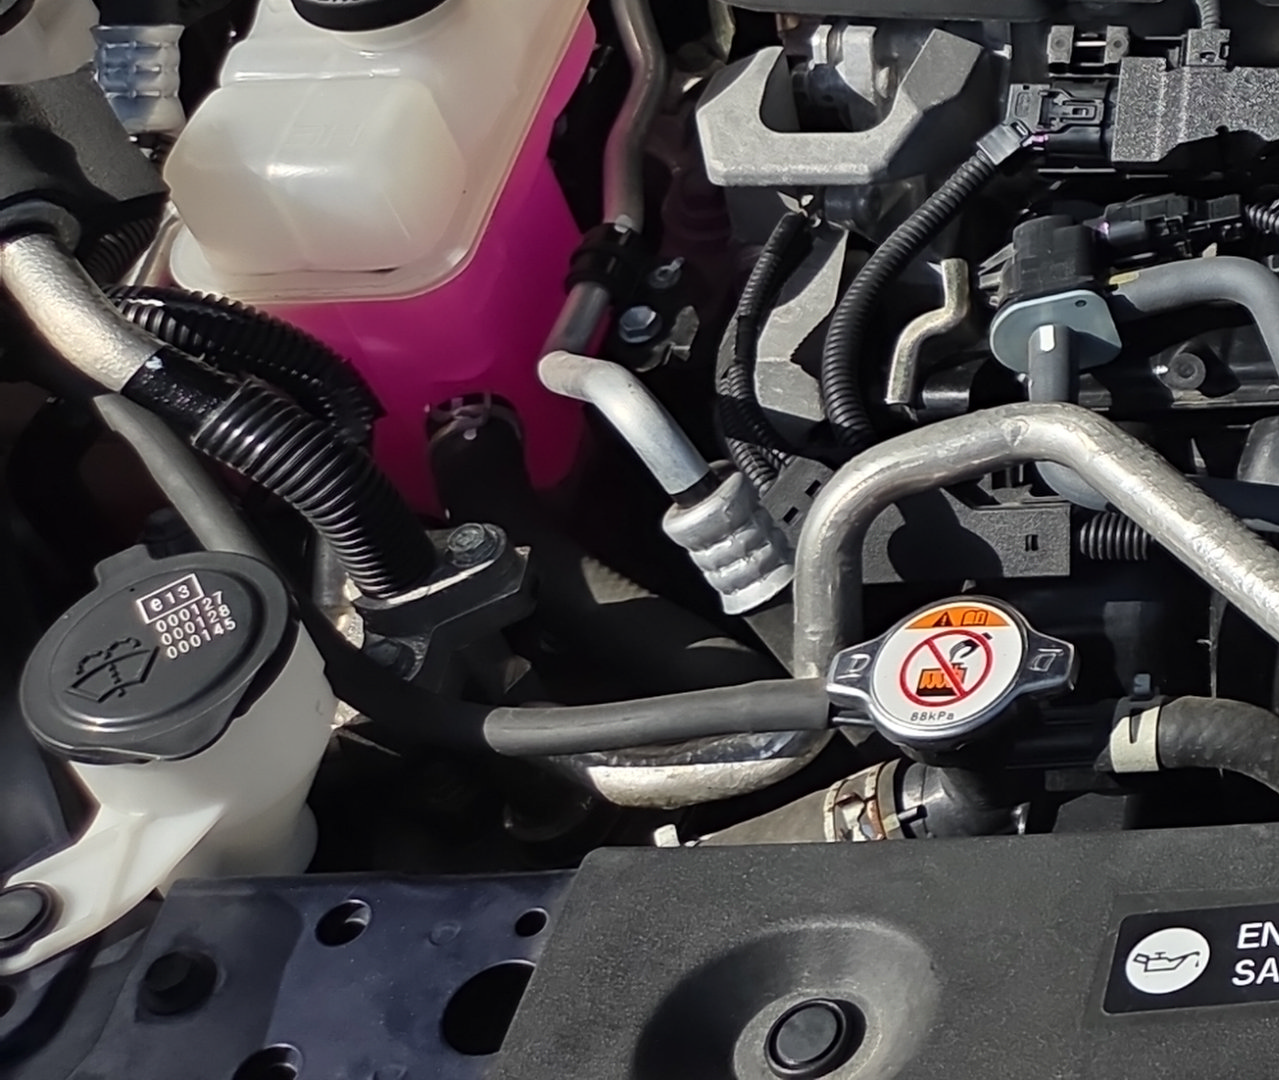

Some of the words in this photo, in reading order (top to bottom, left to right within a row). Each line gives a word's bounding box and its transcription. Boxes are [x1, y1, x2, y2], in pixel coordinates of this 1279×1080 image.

[155, 590, 223, 633] 000127
[161, 604, 231, 646] 000128
[166, 617, 237, 659] 000145
[911, 711, 954, 721] 88kPa
